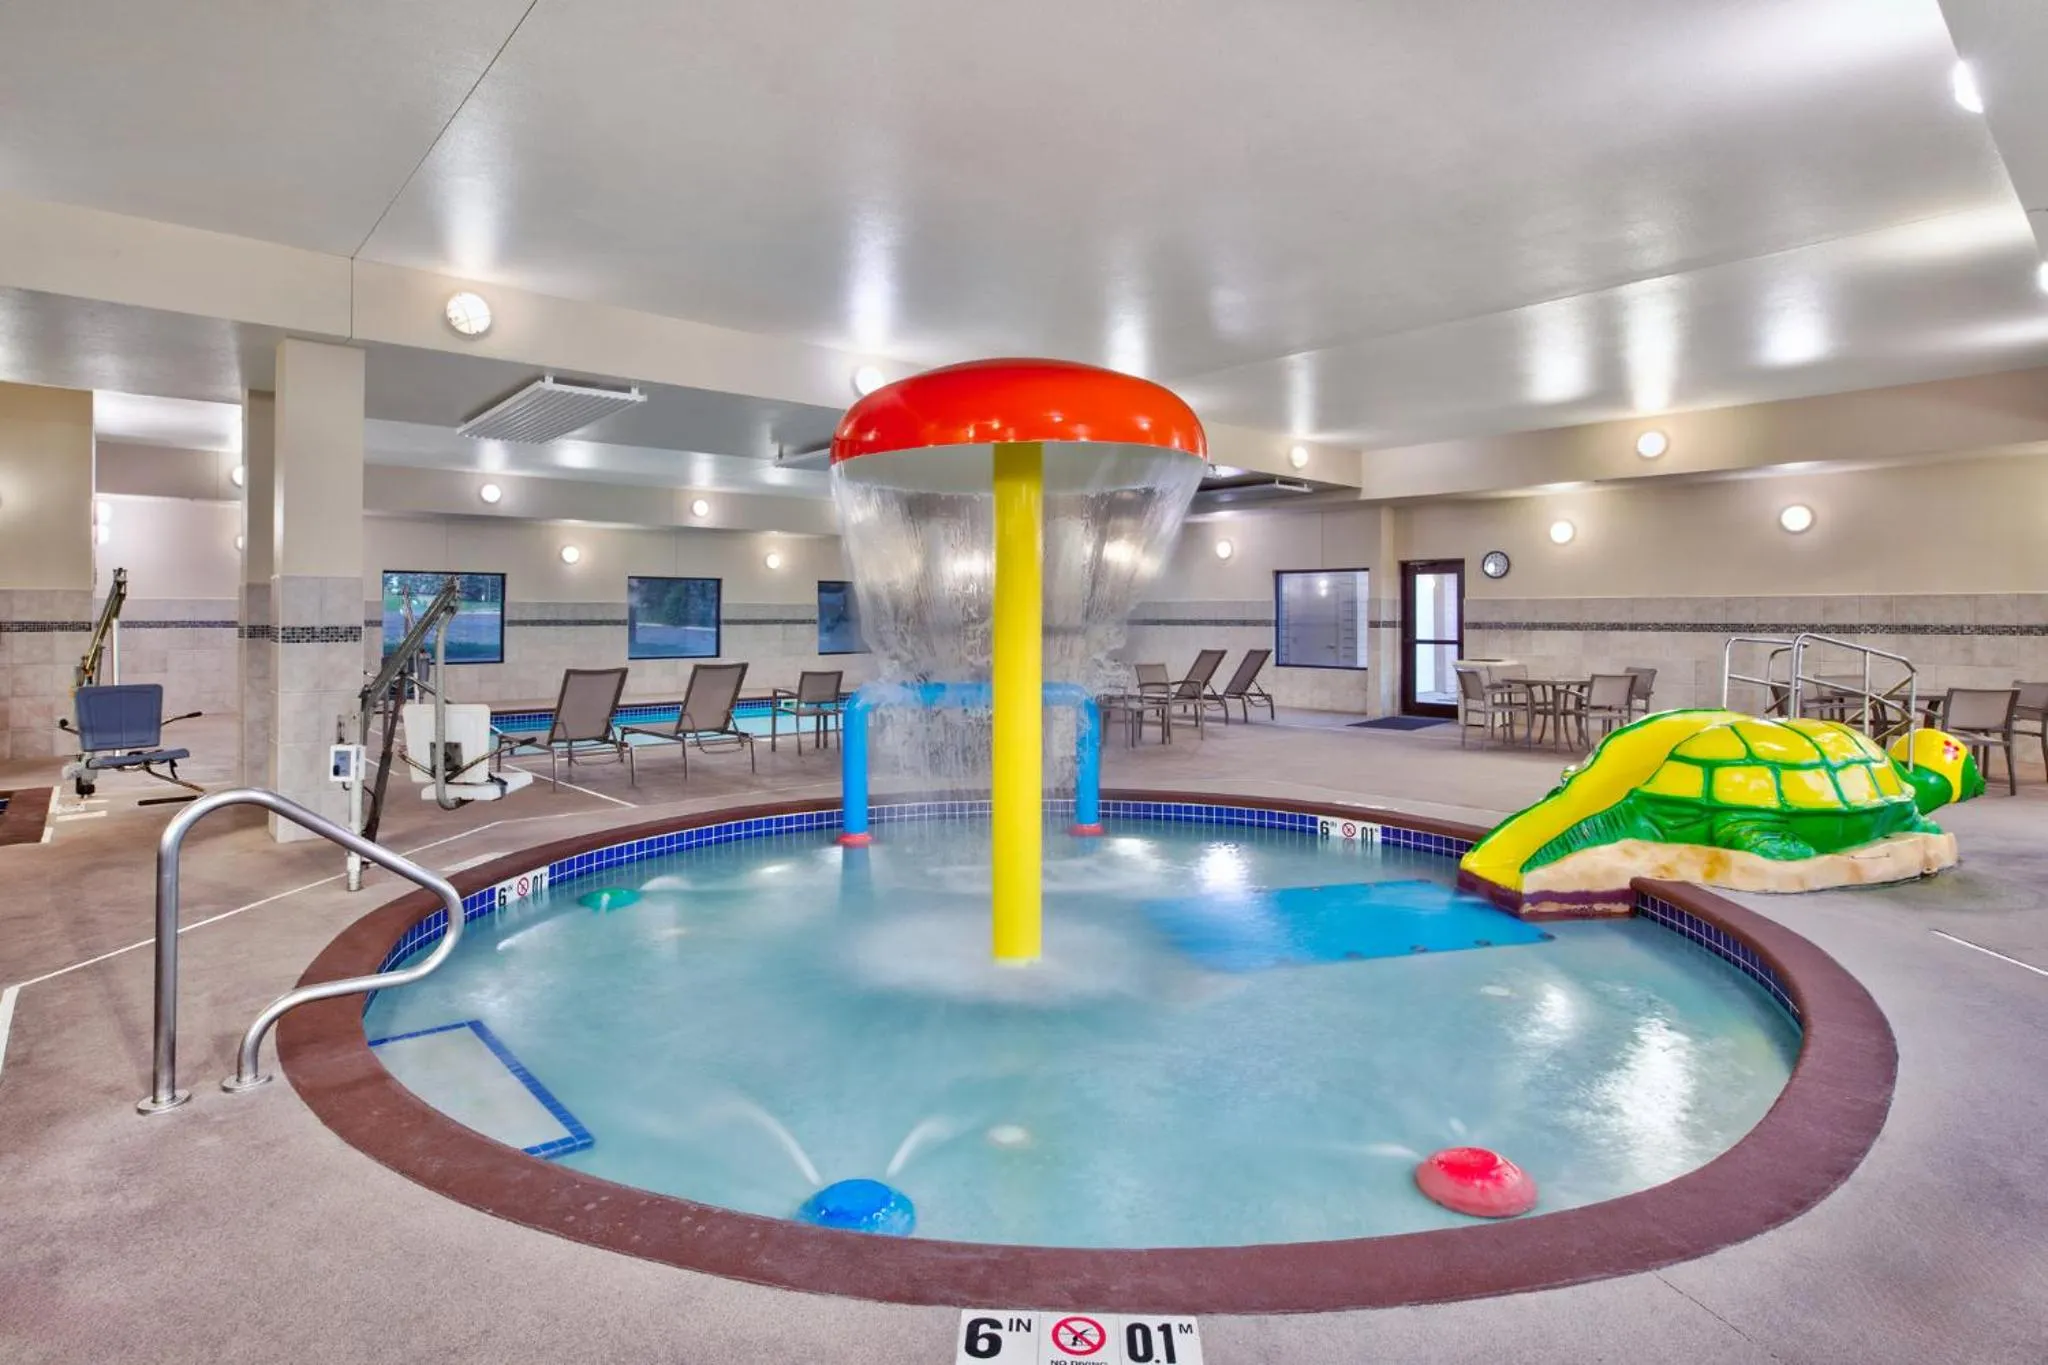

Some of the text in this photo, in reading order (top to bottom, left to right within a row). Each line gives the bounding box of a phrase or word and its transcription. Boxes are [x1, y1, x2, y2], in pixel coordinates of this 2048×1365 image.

[1320, 821, 1329, 835] 6
[498, 888, 506, 907] 6
[964, 1317, 1032, 1359] 6 IN
[1126, 1322, 1193, 1364] 0.1 M
